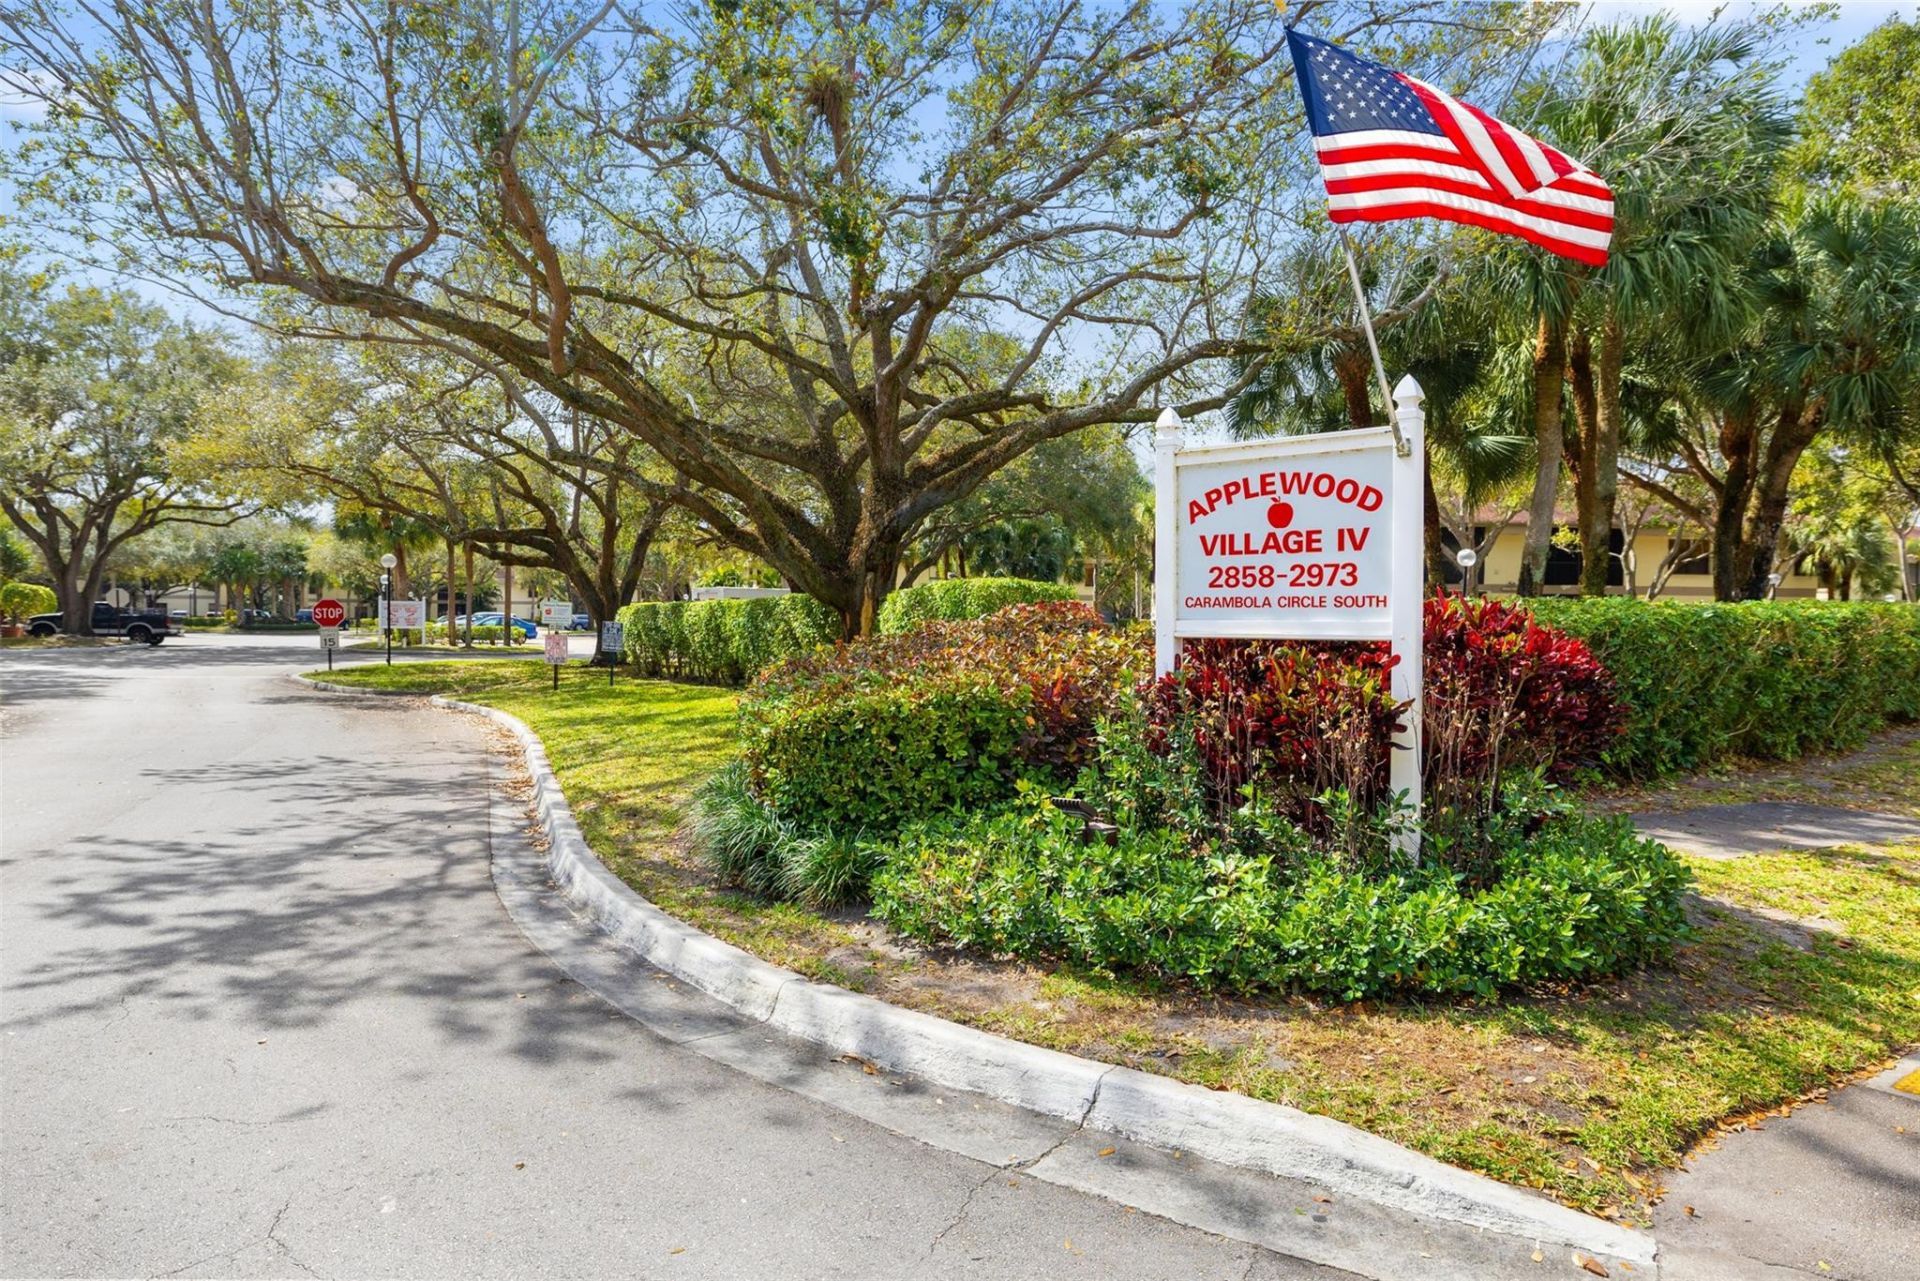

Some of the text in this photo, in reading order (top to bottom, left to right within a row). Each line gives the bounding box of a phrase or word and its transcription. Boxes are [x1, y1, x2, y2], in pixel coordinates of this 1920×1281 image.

[1188, 471, 1384, 524] APPLEWOOD
[1199, 528, 1370, 556] VILLAGE IV
[1208, 563, 1358, 588] 2858-2973
[1185, 595, 1387, 609] CARAMBOLA CIRCLE SOUTH
[315, 607, 343, 619] STOP
[323, 638, 336, 647] 15
